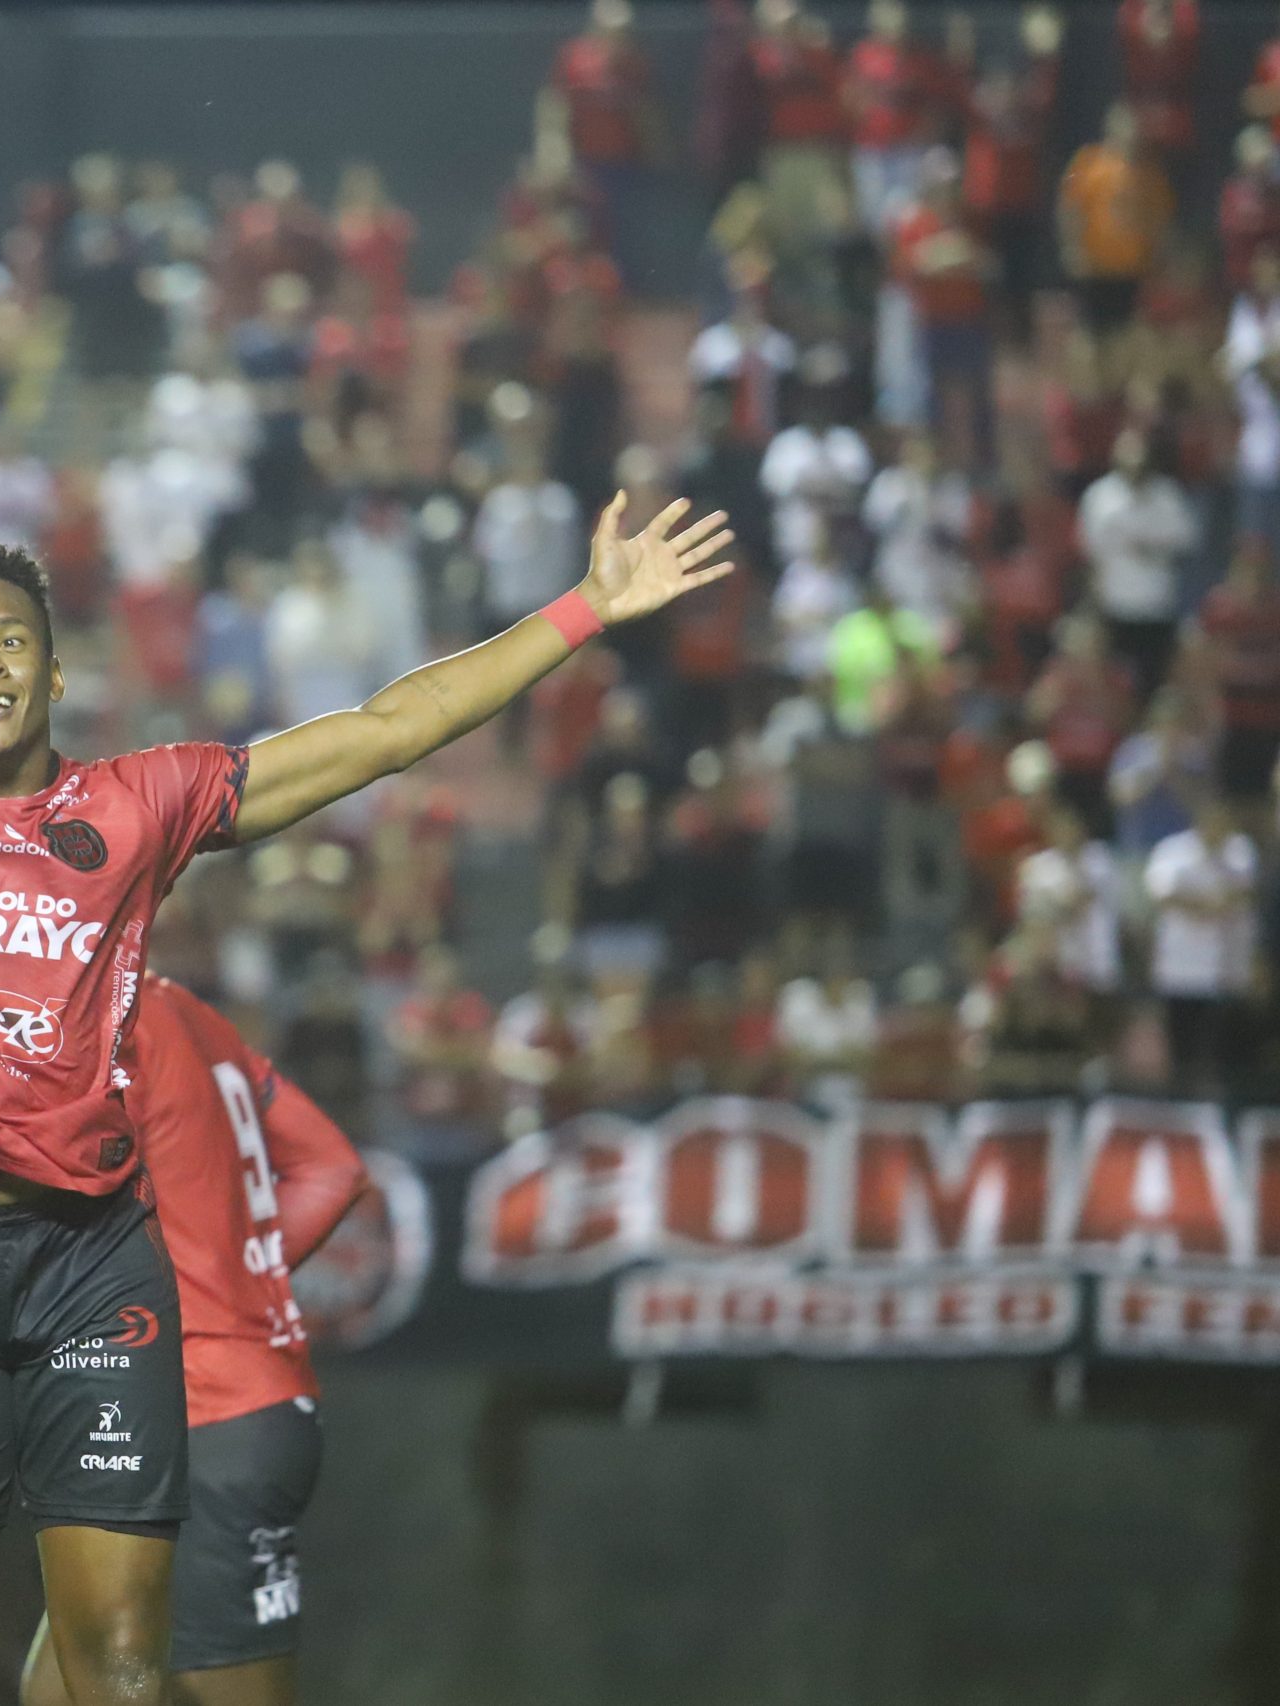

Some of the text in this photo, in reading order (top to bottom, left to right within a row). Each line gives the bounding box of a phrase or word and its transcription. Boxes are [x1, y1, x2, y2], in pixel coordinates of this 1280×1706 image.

[35, 894, 78, 918] DO
[211, 1060, 278, 1222] 9
[50, 1352, 131, 1370] Oliveira
[80, 1454, 144, 1471] CRIARE
